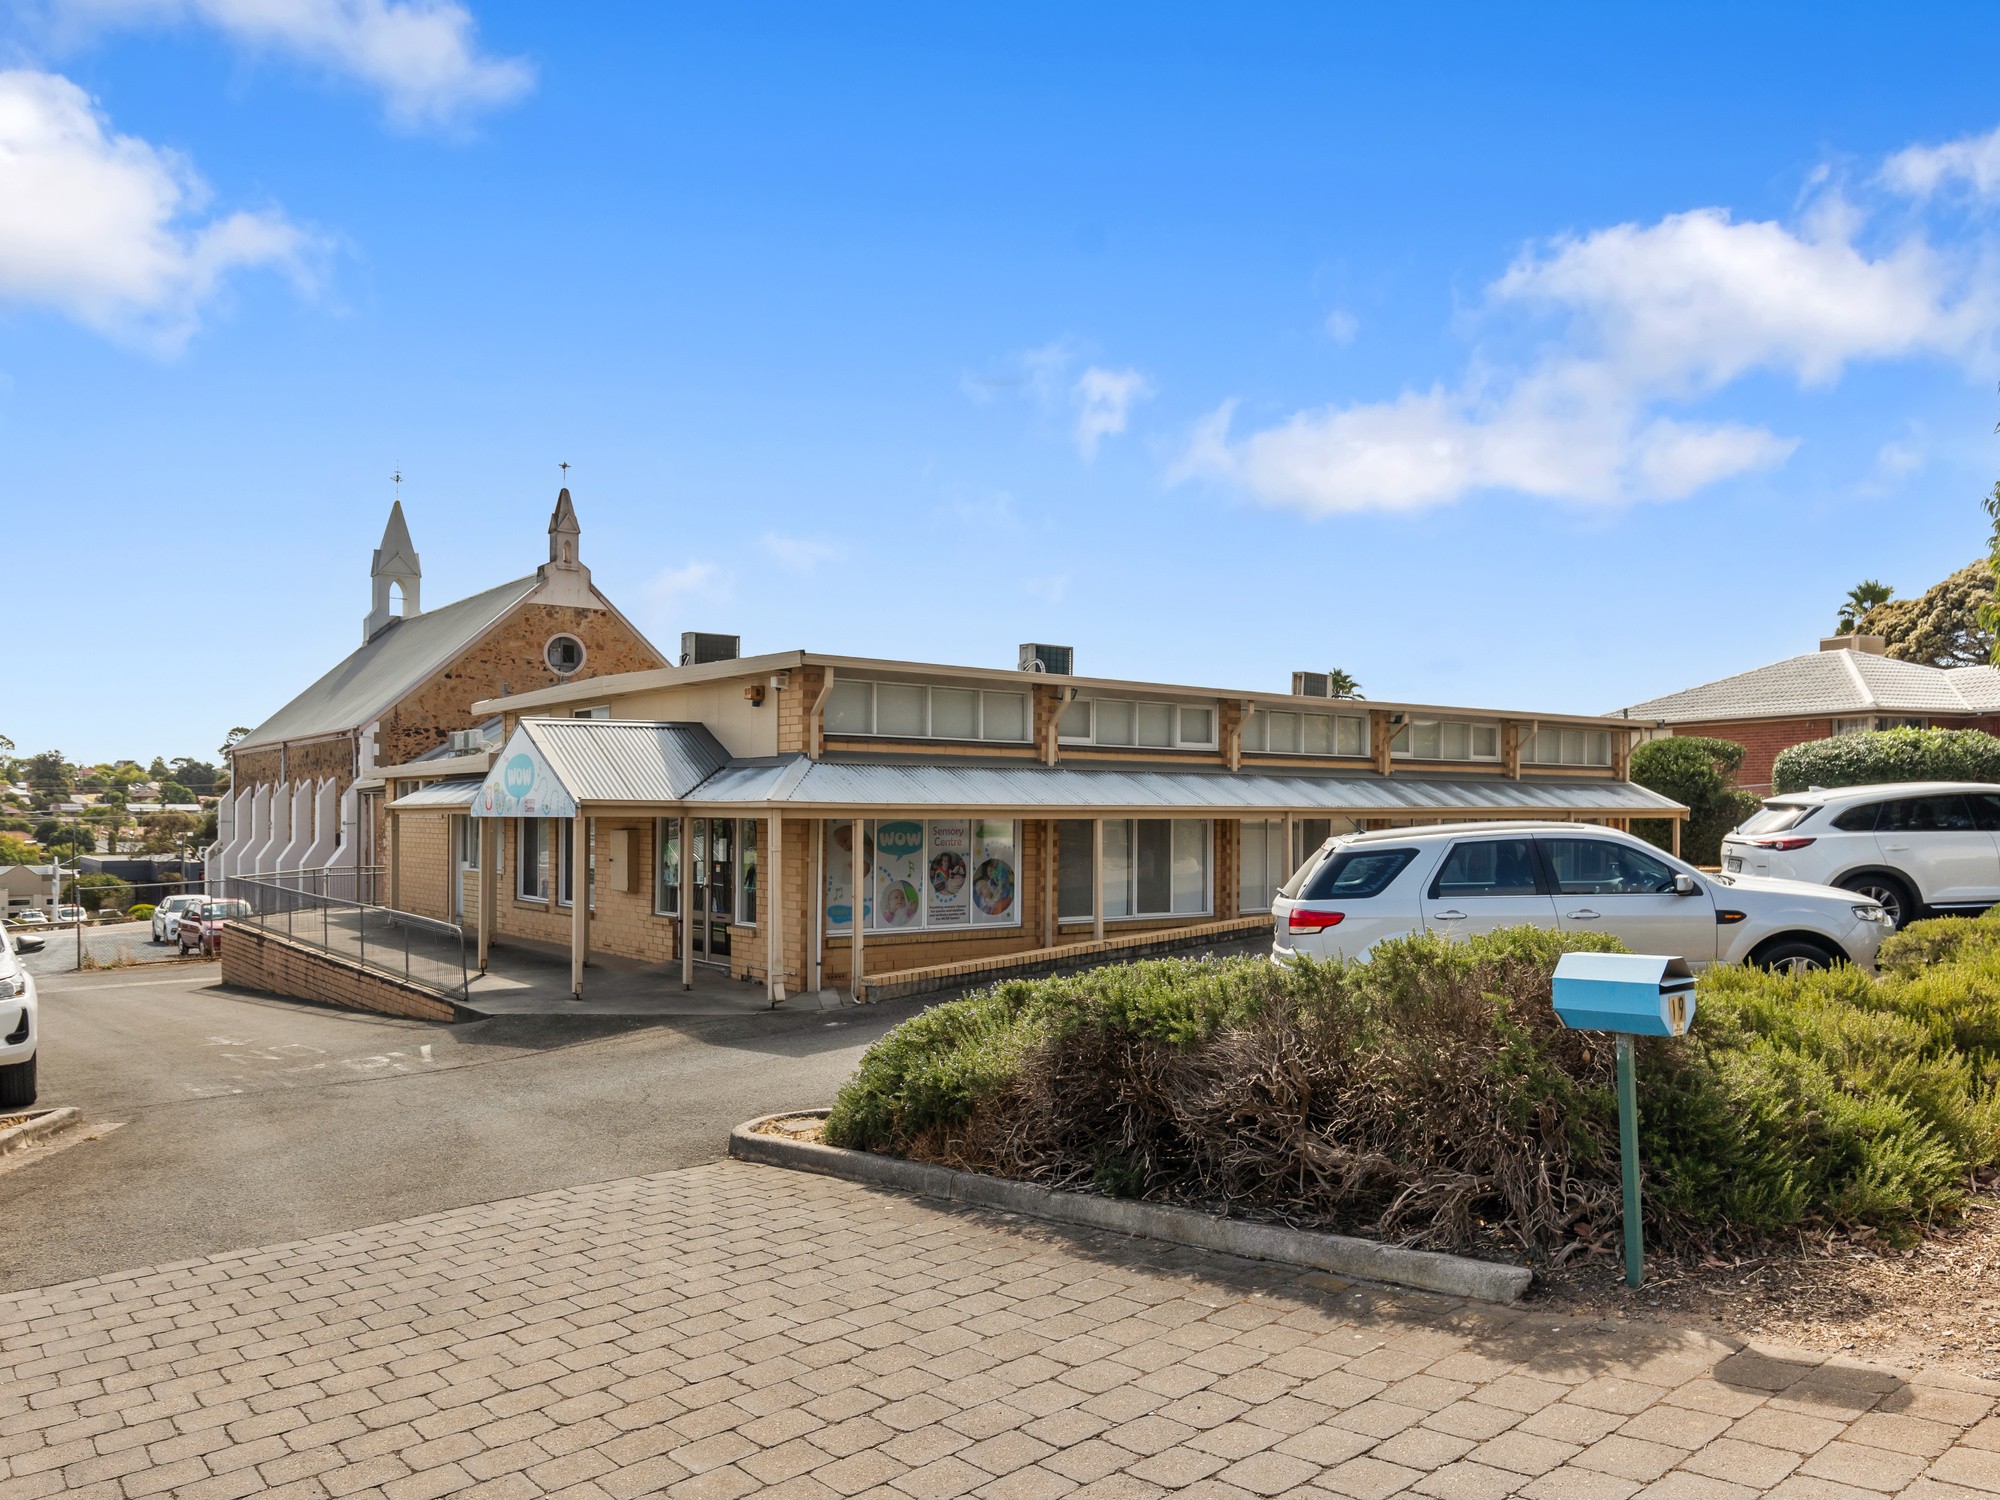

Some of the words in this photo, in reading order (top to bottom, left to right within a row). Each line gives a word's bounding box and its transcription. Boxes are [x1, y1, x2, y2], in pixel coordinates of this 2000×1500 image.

[508, 767, 531, 787] WOW
[879, 831, 921, 847] WOW
[932, 826, 963, 837] Sensory
[934, 837, 962, 847] Centre
[1672, 996, 1684, 1020] 19
